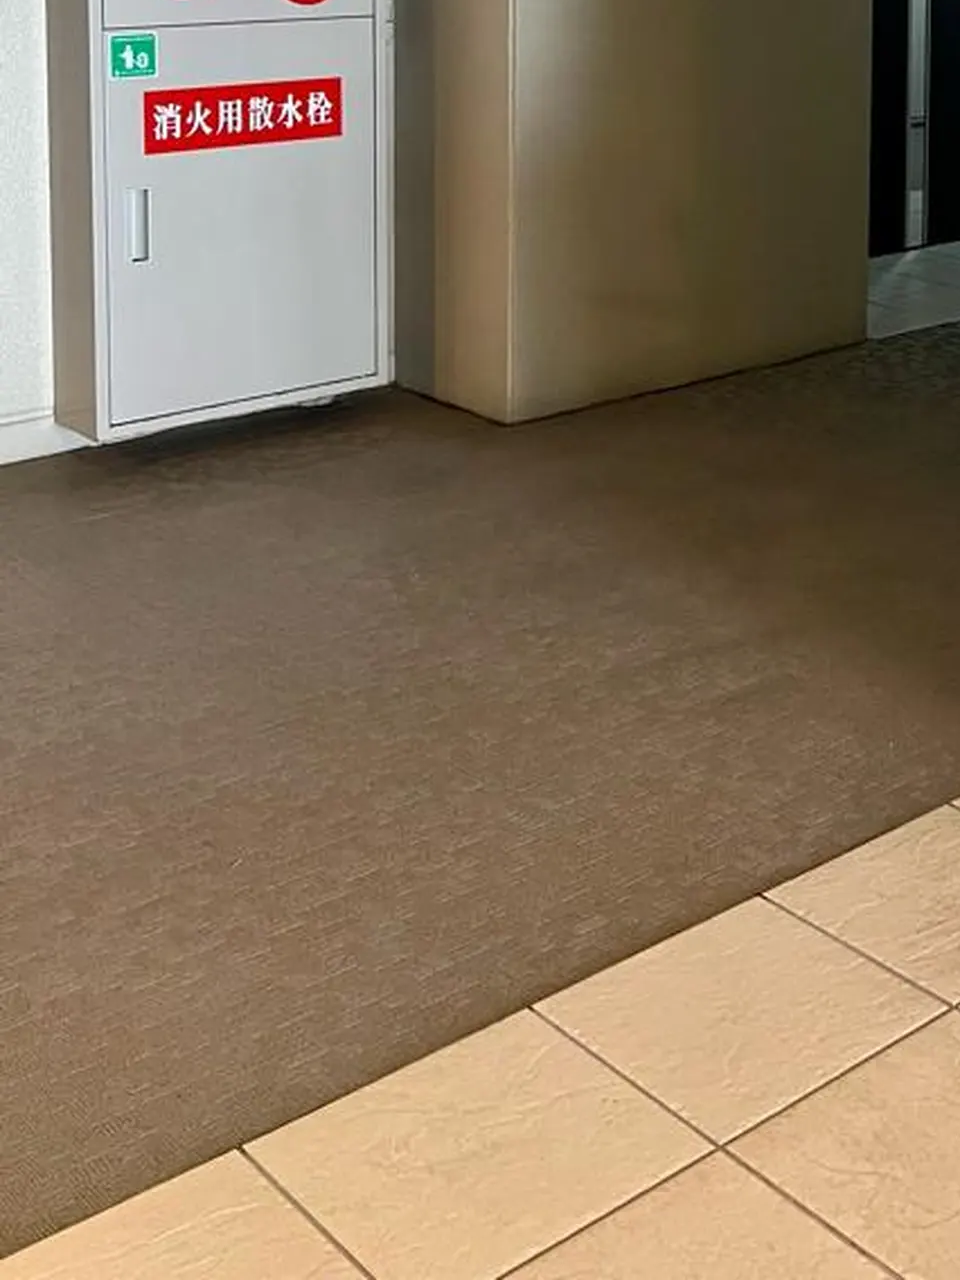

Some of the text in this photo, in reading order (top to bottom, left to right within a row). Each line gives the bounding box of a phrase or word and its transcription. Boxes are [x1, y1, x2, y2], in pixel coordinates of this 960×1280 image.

[153, 91, 333, 140] 消火用散水栓
